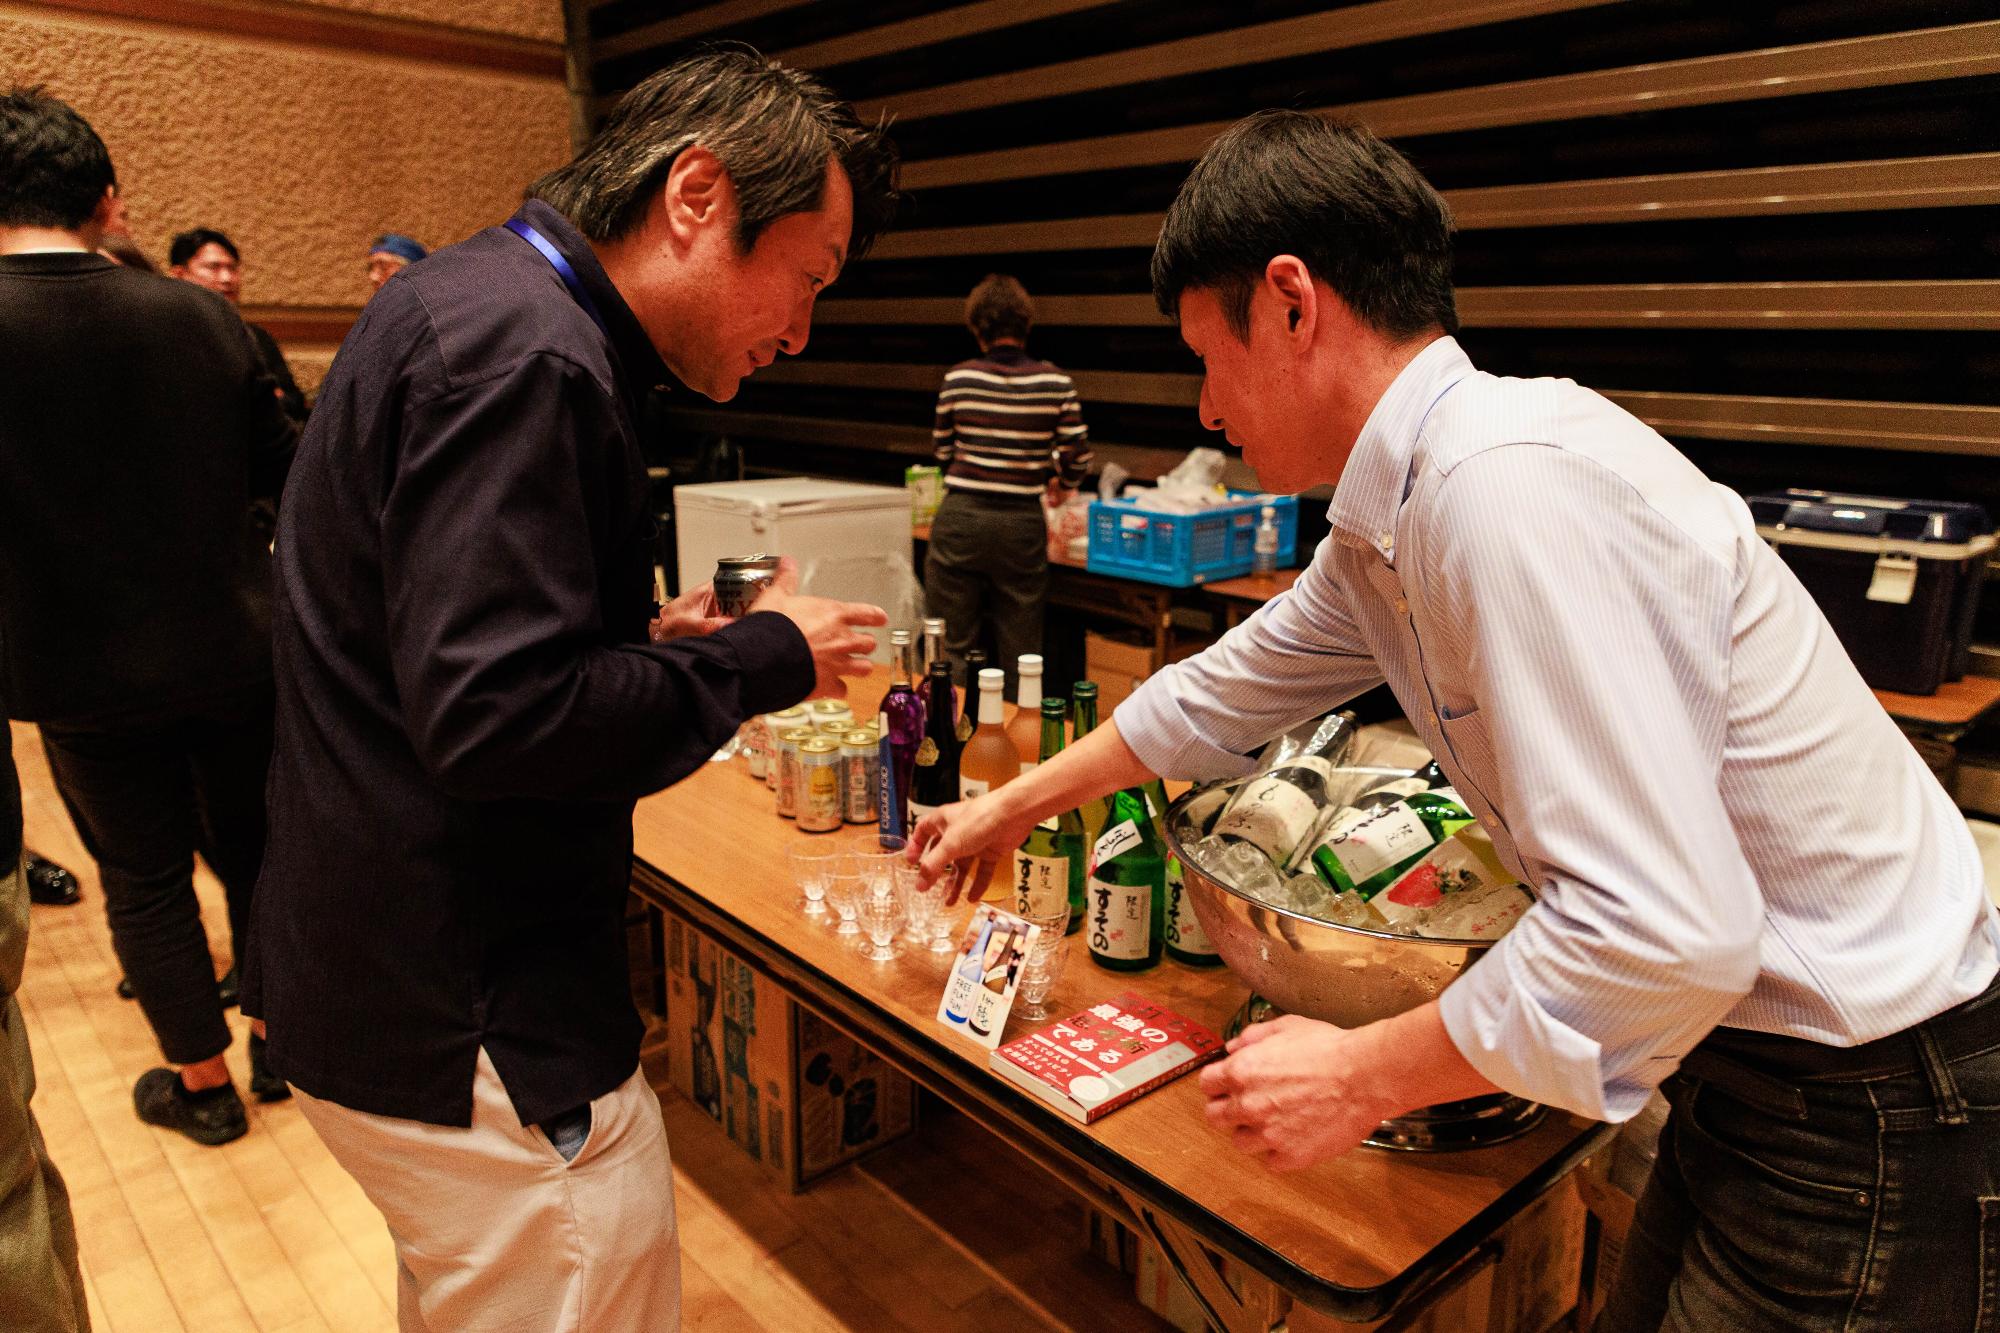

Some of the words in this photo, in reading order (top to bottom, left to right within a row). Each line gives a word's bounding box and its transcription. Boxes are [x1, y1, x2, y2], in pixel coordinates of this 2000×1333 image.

[1052, 1022, 1124, 1064] である
[1087, 1003, 1169, 1043] 最強の
